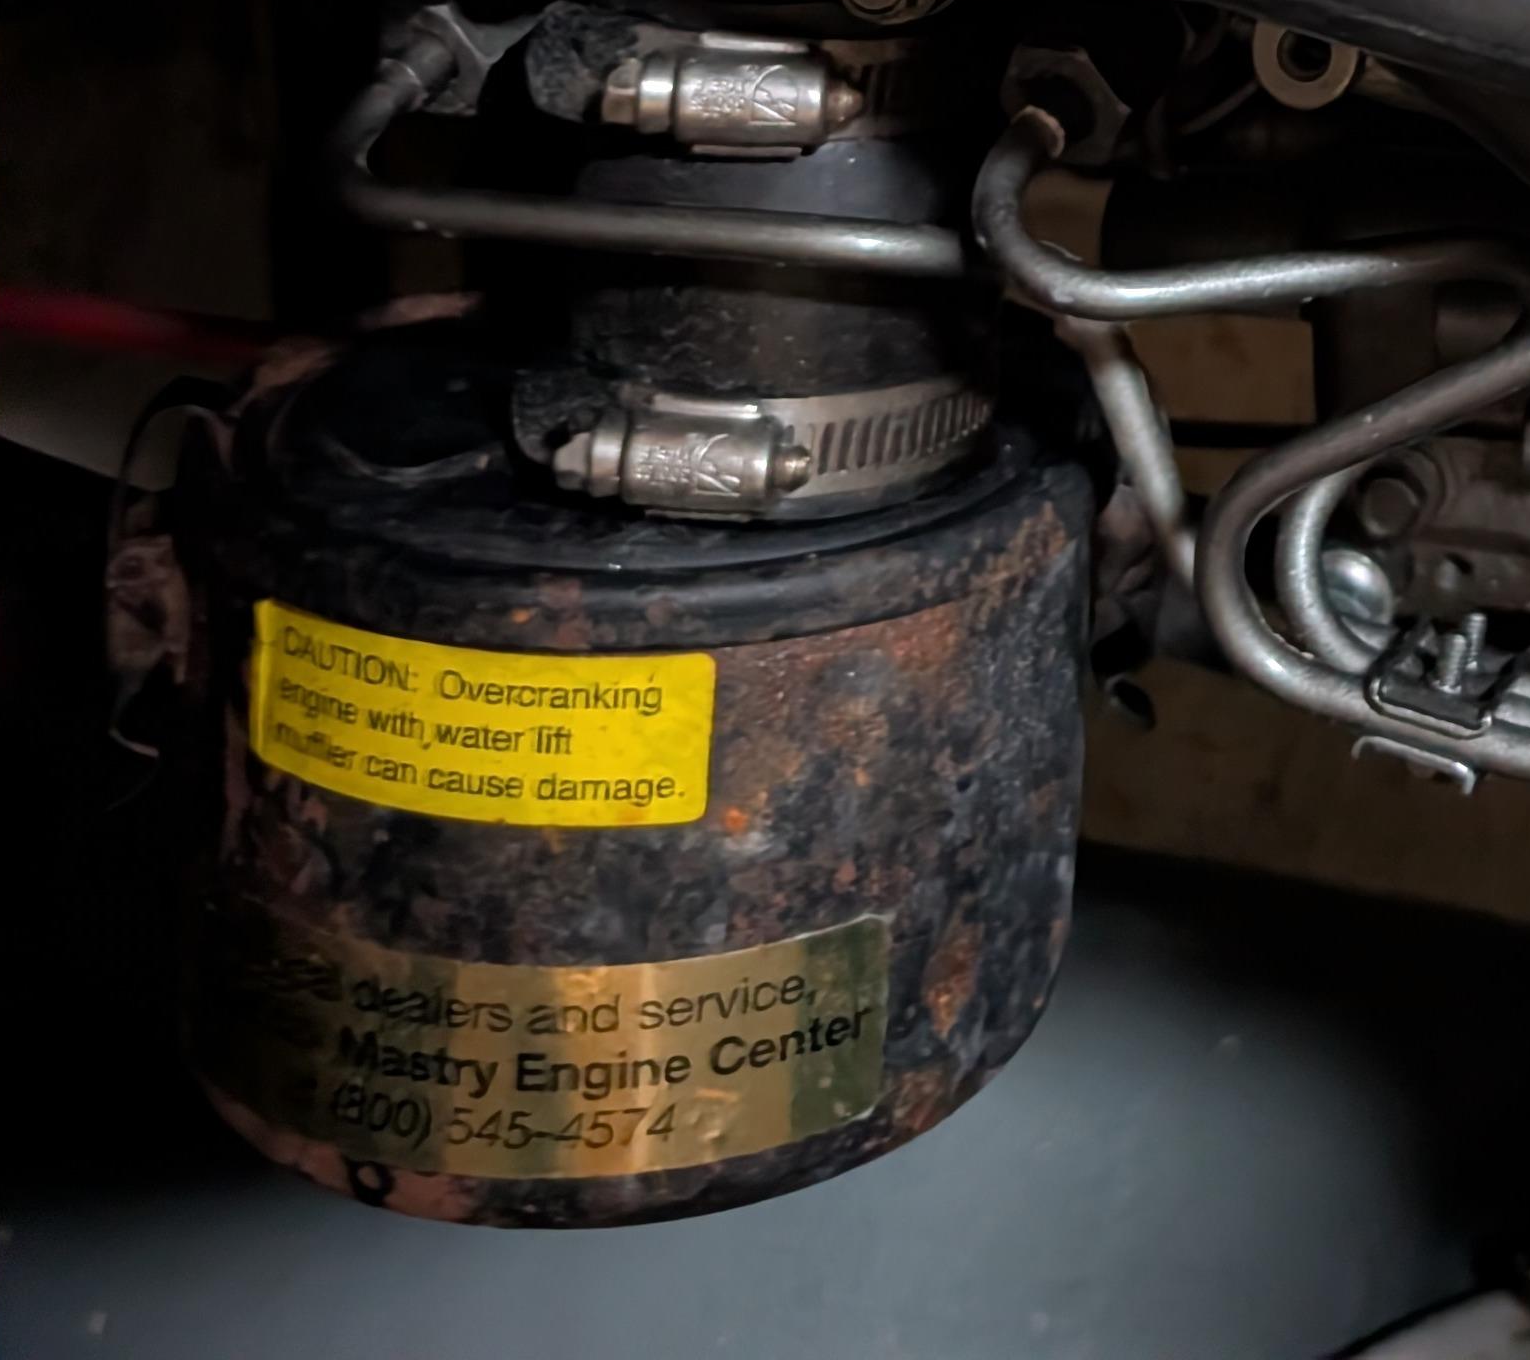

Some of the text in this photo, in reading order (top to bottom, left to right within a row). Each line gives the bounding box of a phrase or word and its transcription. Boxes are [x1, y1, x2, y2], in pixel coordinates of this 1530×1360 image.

[283, 625, 663, 716] CAUTION: Overcranking
[280, 677, 359, 724] engine
[436, 726, 523, 753] water
[535, 726, 572, 755] lift
[365, 753, 417, 783] can
[427, 767, 523, 798] cause
[536, 774, 685, 807] damage.
[353, 977, 513, 1032] dealers
[526, 994, 621, 1035] and
[639, 975, 817, 1030] service,
[339, 1007, 871, 1100] Mastry Engine Center
[333, 1081, 676, 1150] (800) 545-4574
